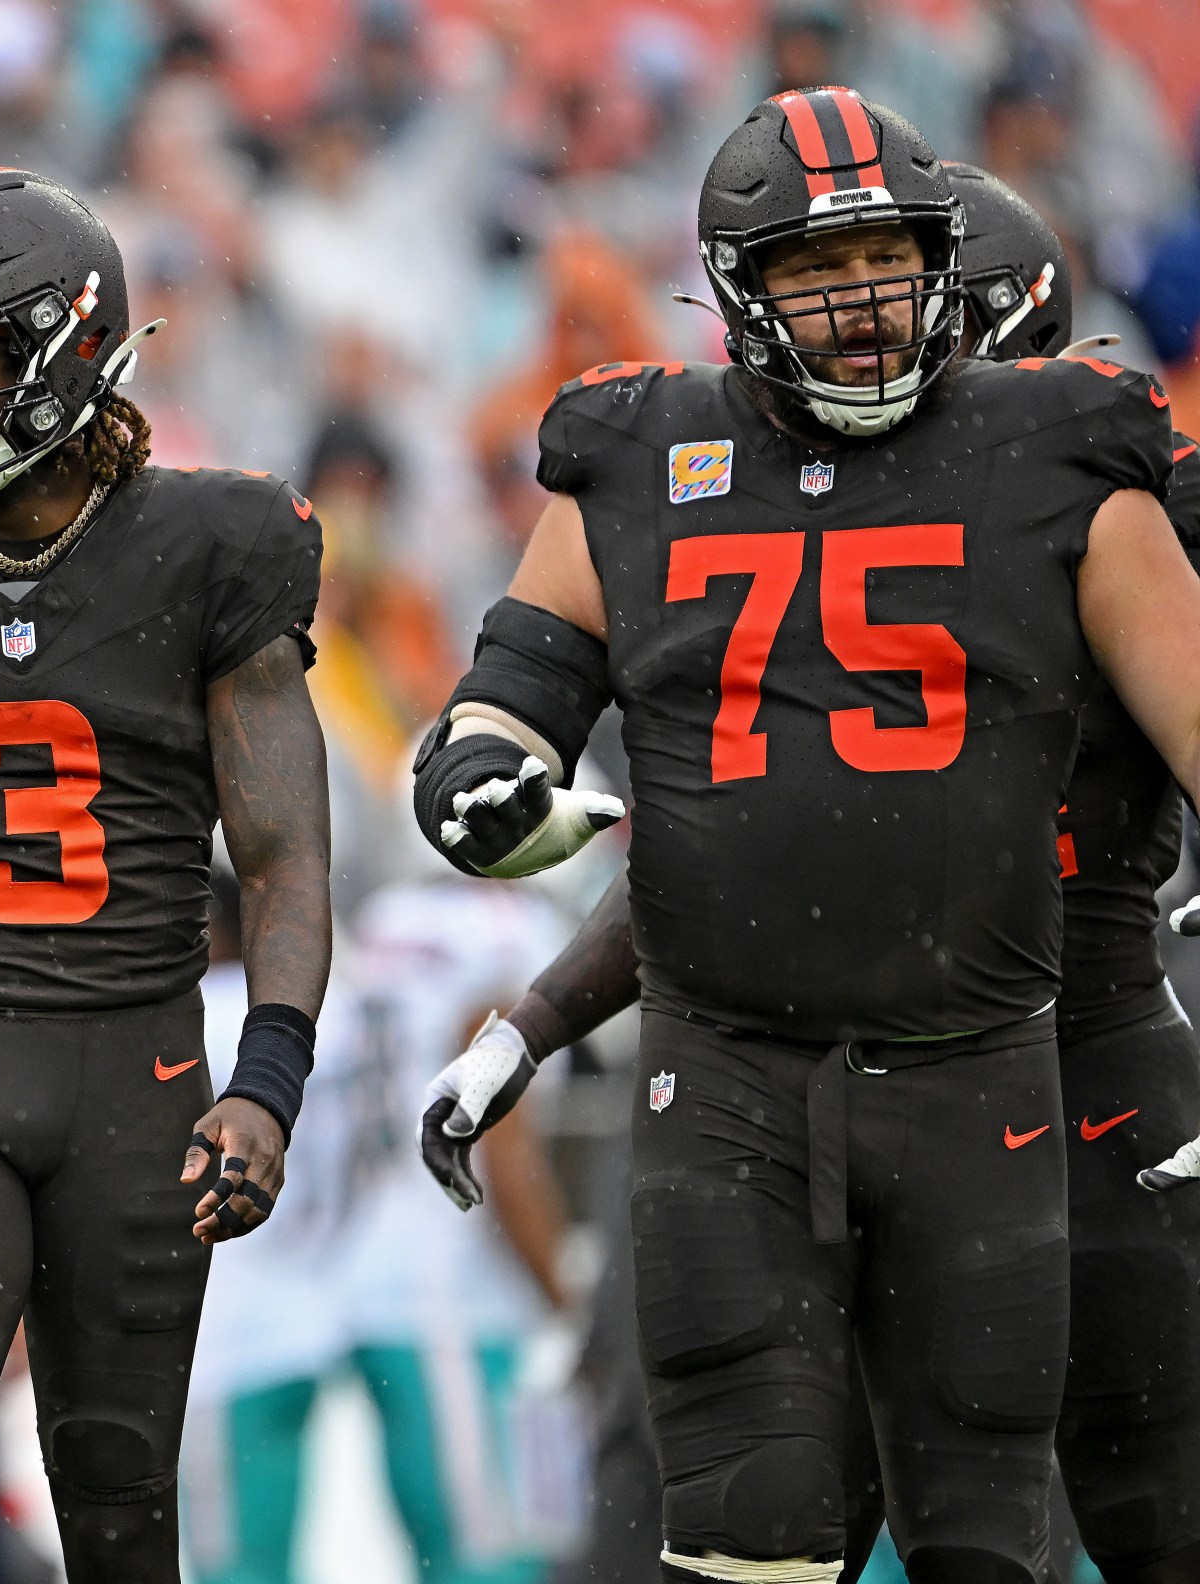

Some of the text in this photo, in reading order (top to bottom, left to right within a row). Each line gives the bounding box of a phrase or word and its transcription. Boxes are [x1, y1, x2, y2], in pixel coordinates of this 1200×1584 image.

[830, 190, 873, 206] BROWNS
[674, 444, 729, 485] C
[805, 474, 829, 489] NFL
[7, 637, 31, 654] NFL
[665, 523, 967, 784] 75
[652, 1088, 669, 1105] NFL
